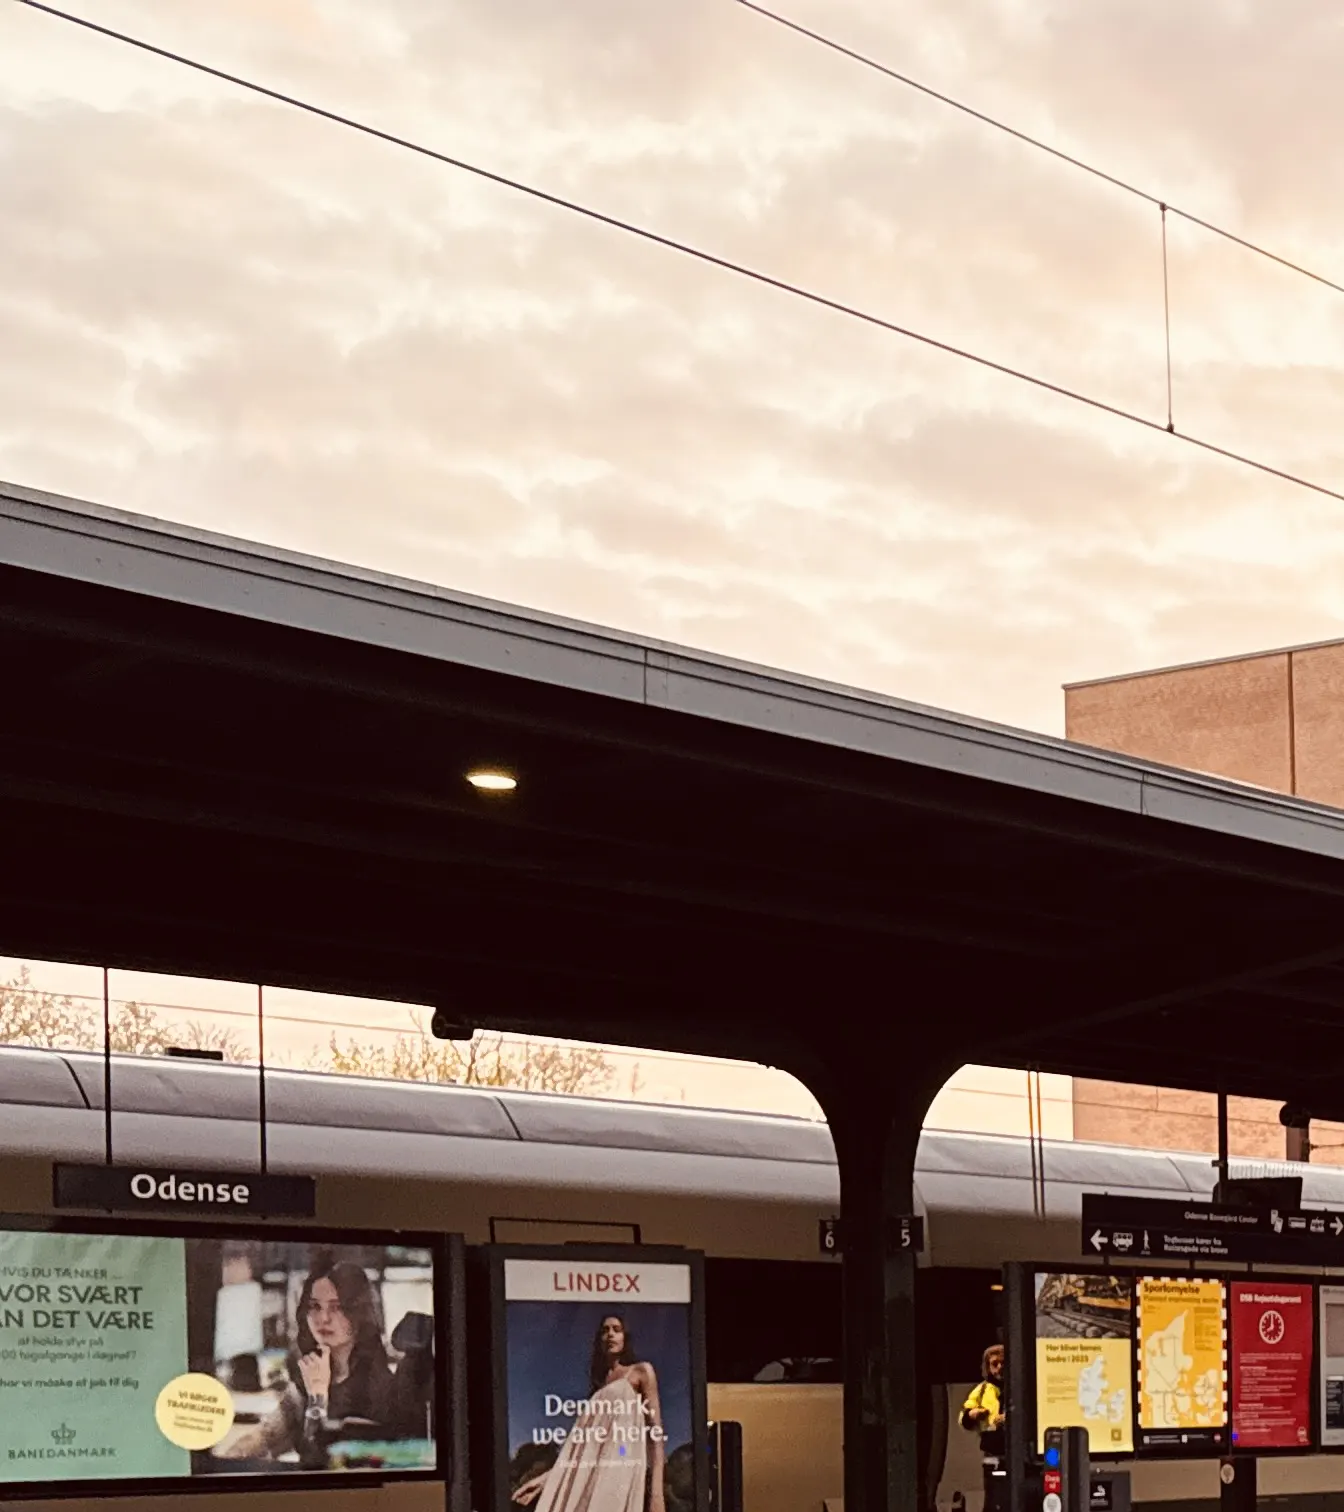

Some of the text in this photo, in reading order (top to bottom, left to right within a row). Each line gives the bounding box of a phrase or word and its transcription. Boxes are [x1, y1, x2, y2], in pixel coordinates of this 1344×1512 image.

[131, 1174, 249, 1204] Odense
[825, 1231, 834, 1248] 6
[901, 1229, 910, 1247] 5
[32, 1267, 51, 1278] DU
[553, 1272, 640, 1293] LINDEX
[57, 1285, 143, 1304] SVÆRT
[0, 1309, 154, 1329] N DET VÆRE
[532, 1421, 668, 1445] we are here.
[8, 1448, 117, 1460] BANEDANMARK
